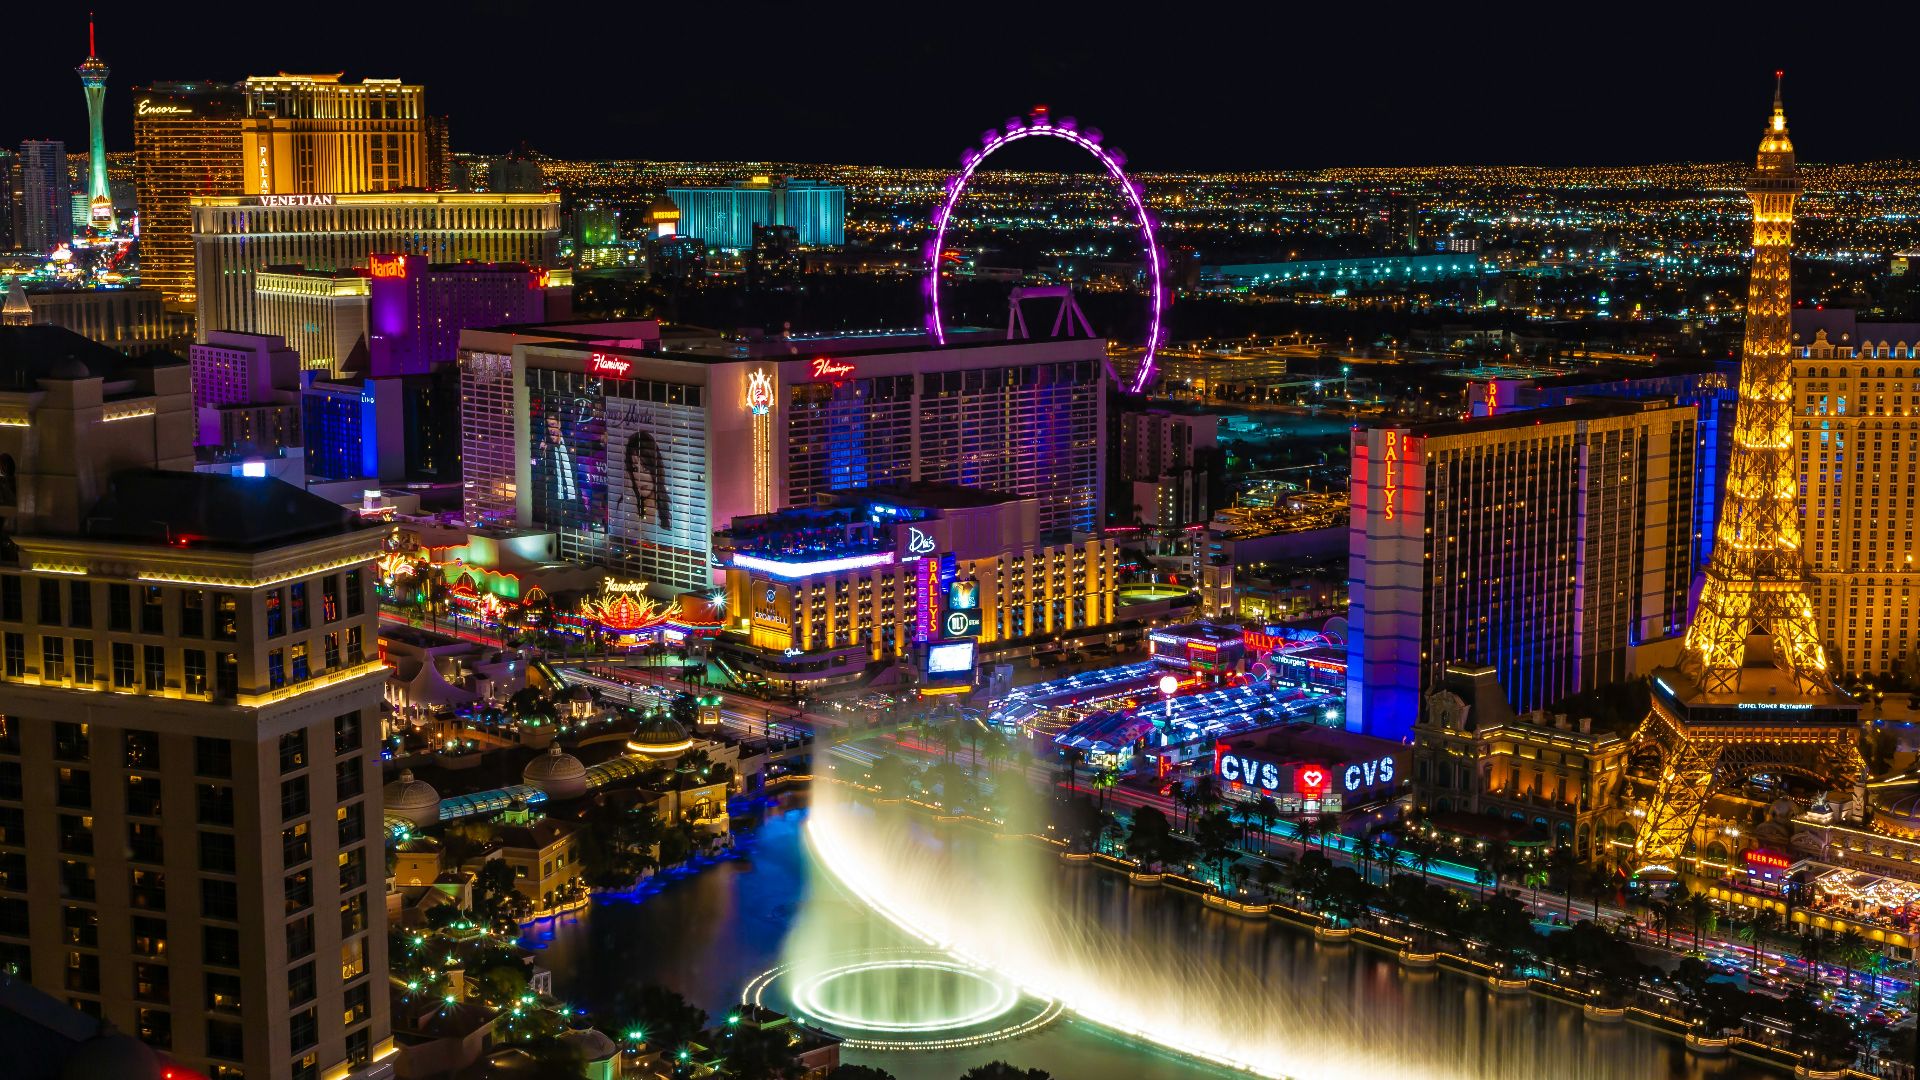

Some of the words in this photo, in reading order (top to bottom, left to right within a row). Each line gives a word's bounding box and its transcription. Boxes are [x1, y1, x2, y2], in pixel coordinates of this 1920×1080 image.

[138, 100, 192, 115] Encore
[260, 194, 333, 206] VENETIAN
[593, 353, 631, 376] Flamingo
[812, 358, 855, 378] Flamingo
[1384, 431, 1397, 520] BALLYS
[604, 576, 649, 594] Flamingo
[928, 561, 938, 631] BALLYS
[951, 616, 964, 630] BLT
[1244, 631, 1284, 649] BALLY'S
[1221, 755, 1279, 790] CVS
[1345, 756, 1393, 791] CVS
[1747, 852, 1767, 864] BEER
[1768, 857, 1788, 868] PARK
